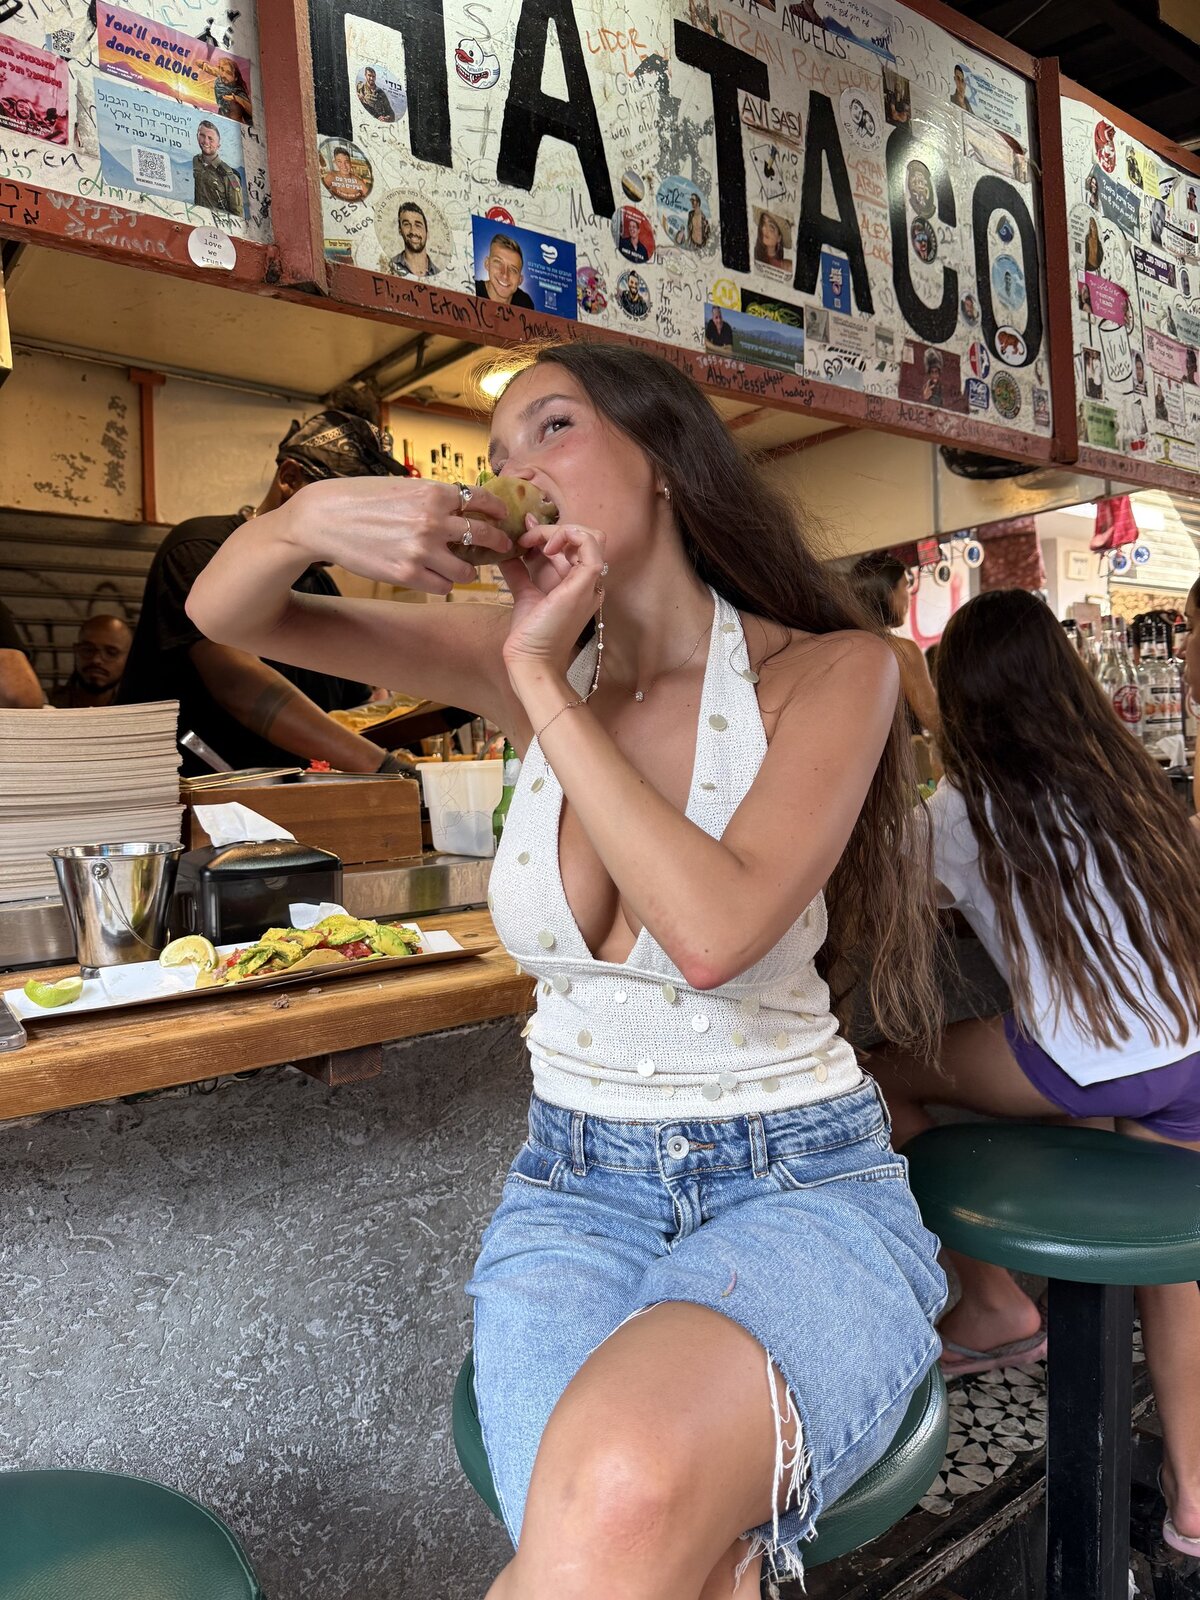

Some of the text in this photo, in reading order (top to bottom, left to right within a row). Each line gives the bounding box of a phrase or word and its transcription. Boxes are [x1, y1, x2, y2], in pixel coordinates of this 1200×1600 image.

[105, 13, 191, 58] You'll never
[106, 35, 151, 62] dance
[97, 89, 129, 108] הגבול
[133, 102, 149, 113] הם
[742, 93, 769, 128] AVI
[135, 115, 156, 127] דרך
[343, 216, 375, 236] tacos
[209, 232, 218, 240] in
[204, 239, 222, 250] love
[207, 249, 218, 257] we
[201, 257, 224, 266] trust
